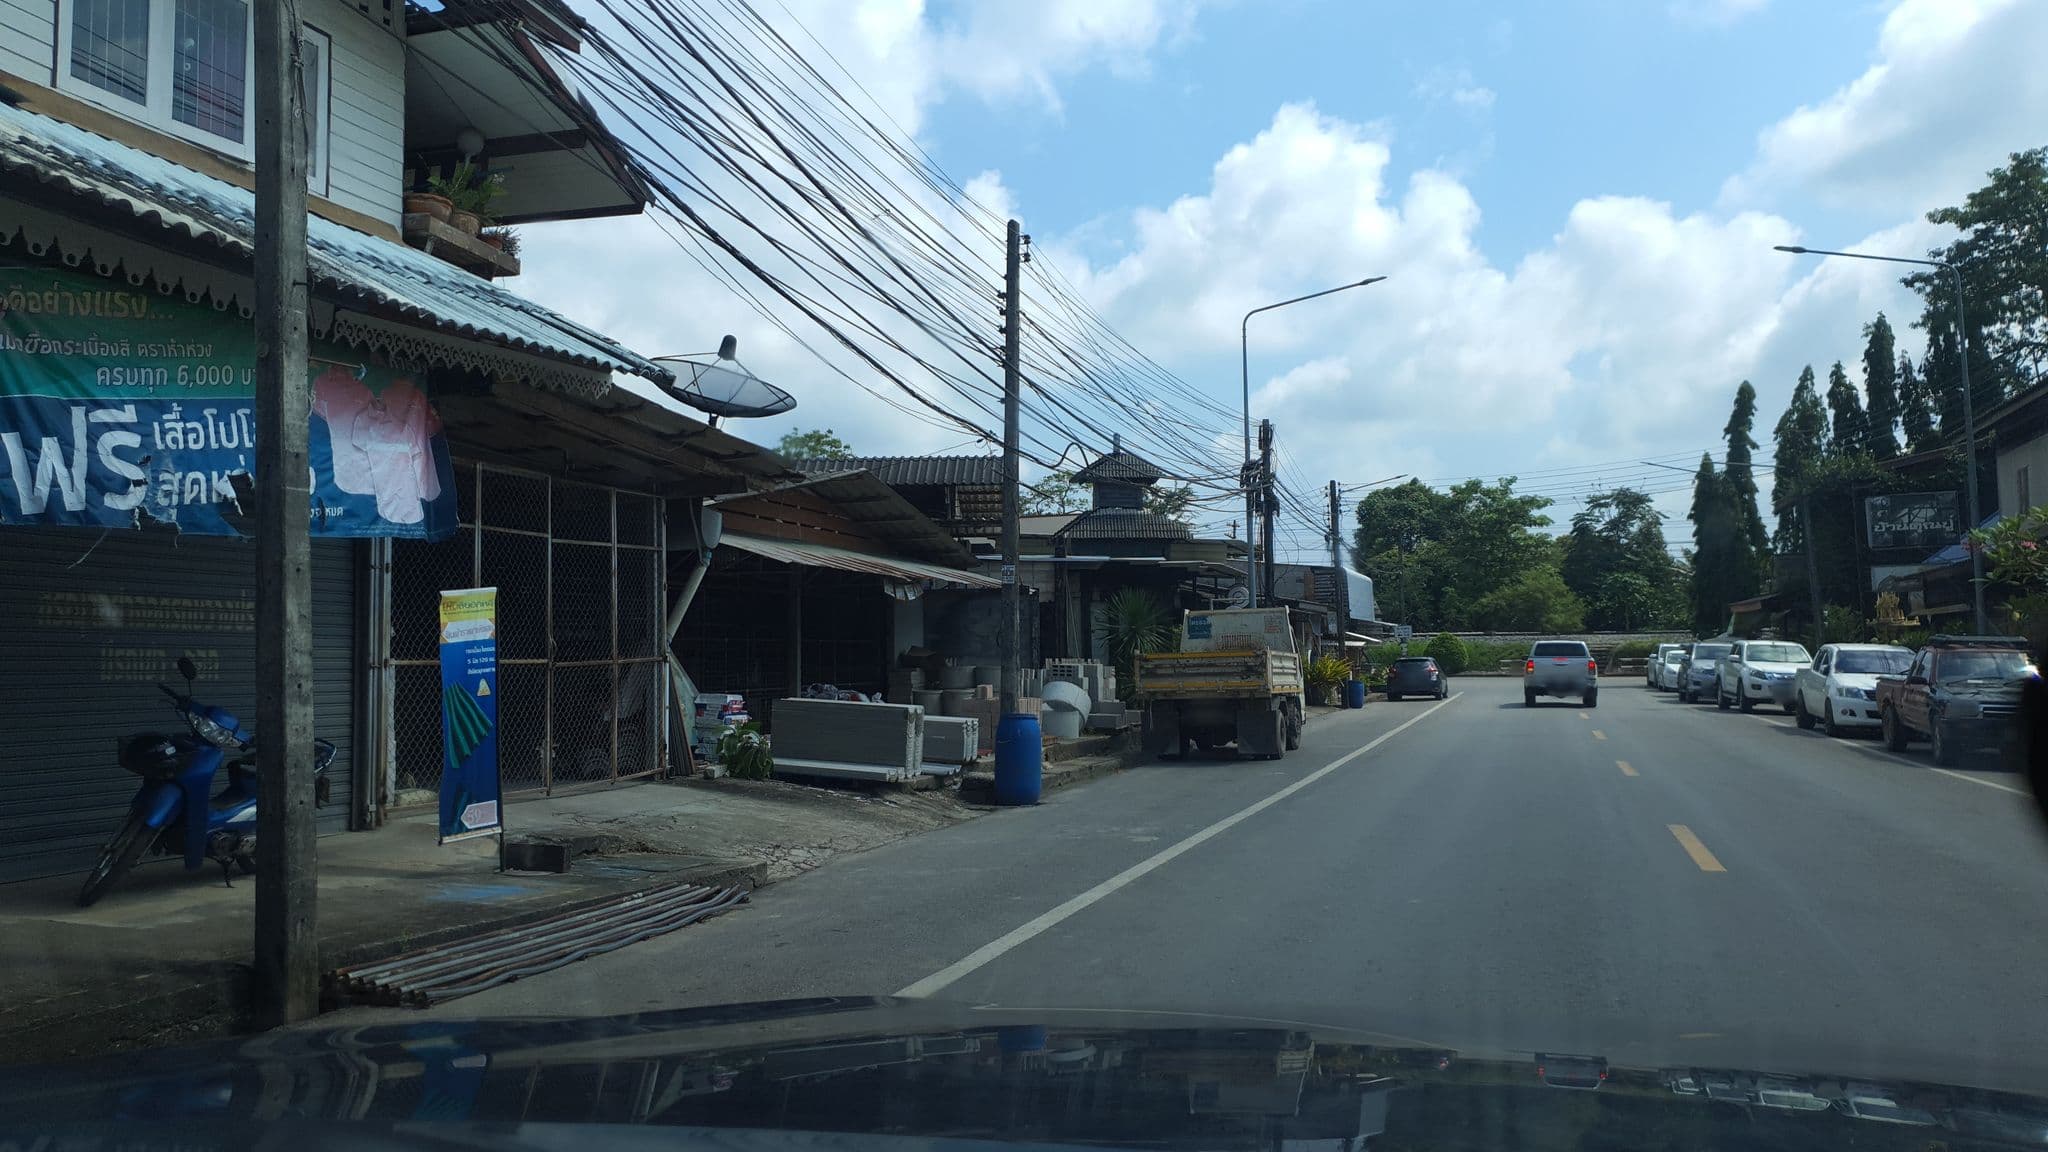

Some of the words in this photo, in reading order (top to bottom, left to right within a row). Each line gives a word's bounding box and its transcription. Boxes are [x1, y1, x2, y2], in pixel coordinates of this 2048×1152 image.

[138, 338, 212, 358] ตราห้าห่วง
[96, 366, 168, 393] ครบทุก
[177, 365, 233, 388] 6,000
[242, 368, 256, 386] บ
[153, 403, 256, 450] เสื้อโปโ
[1, 404, 146, 515] ฟรี
